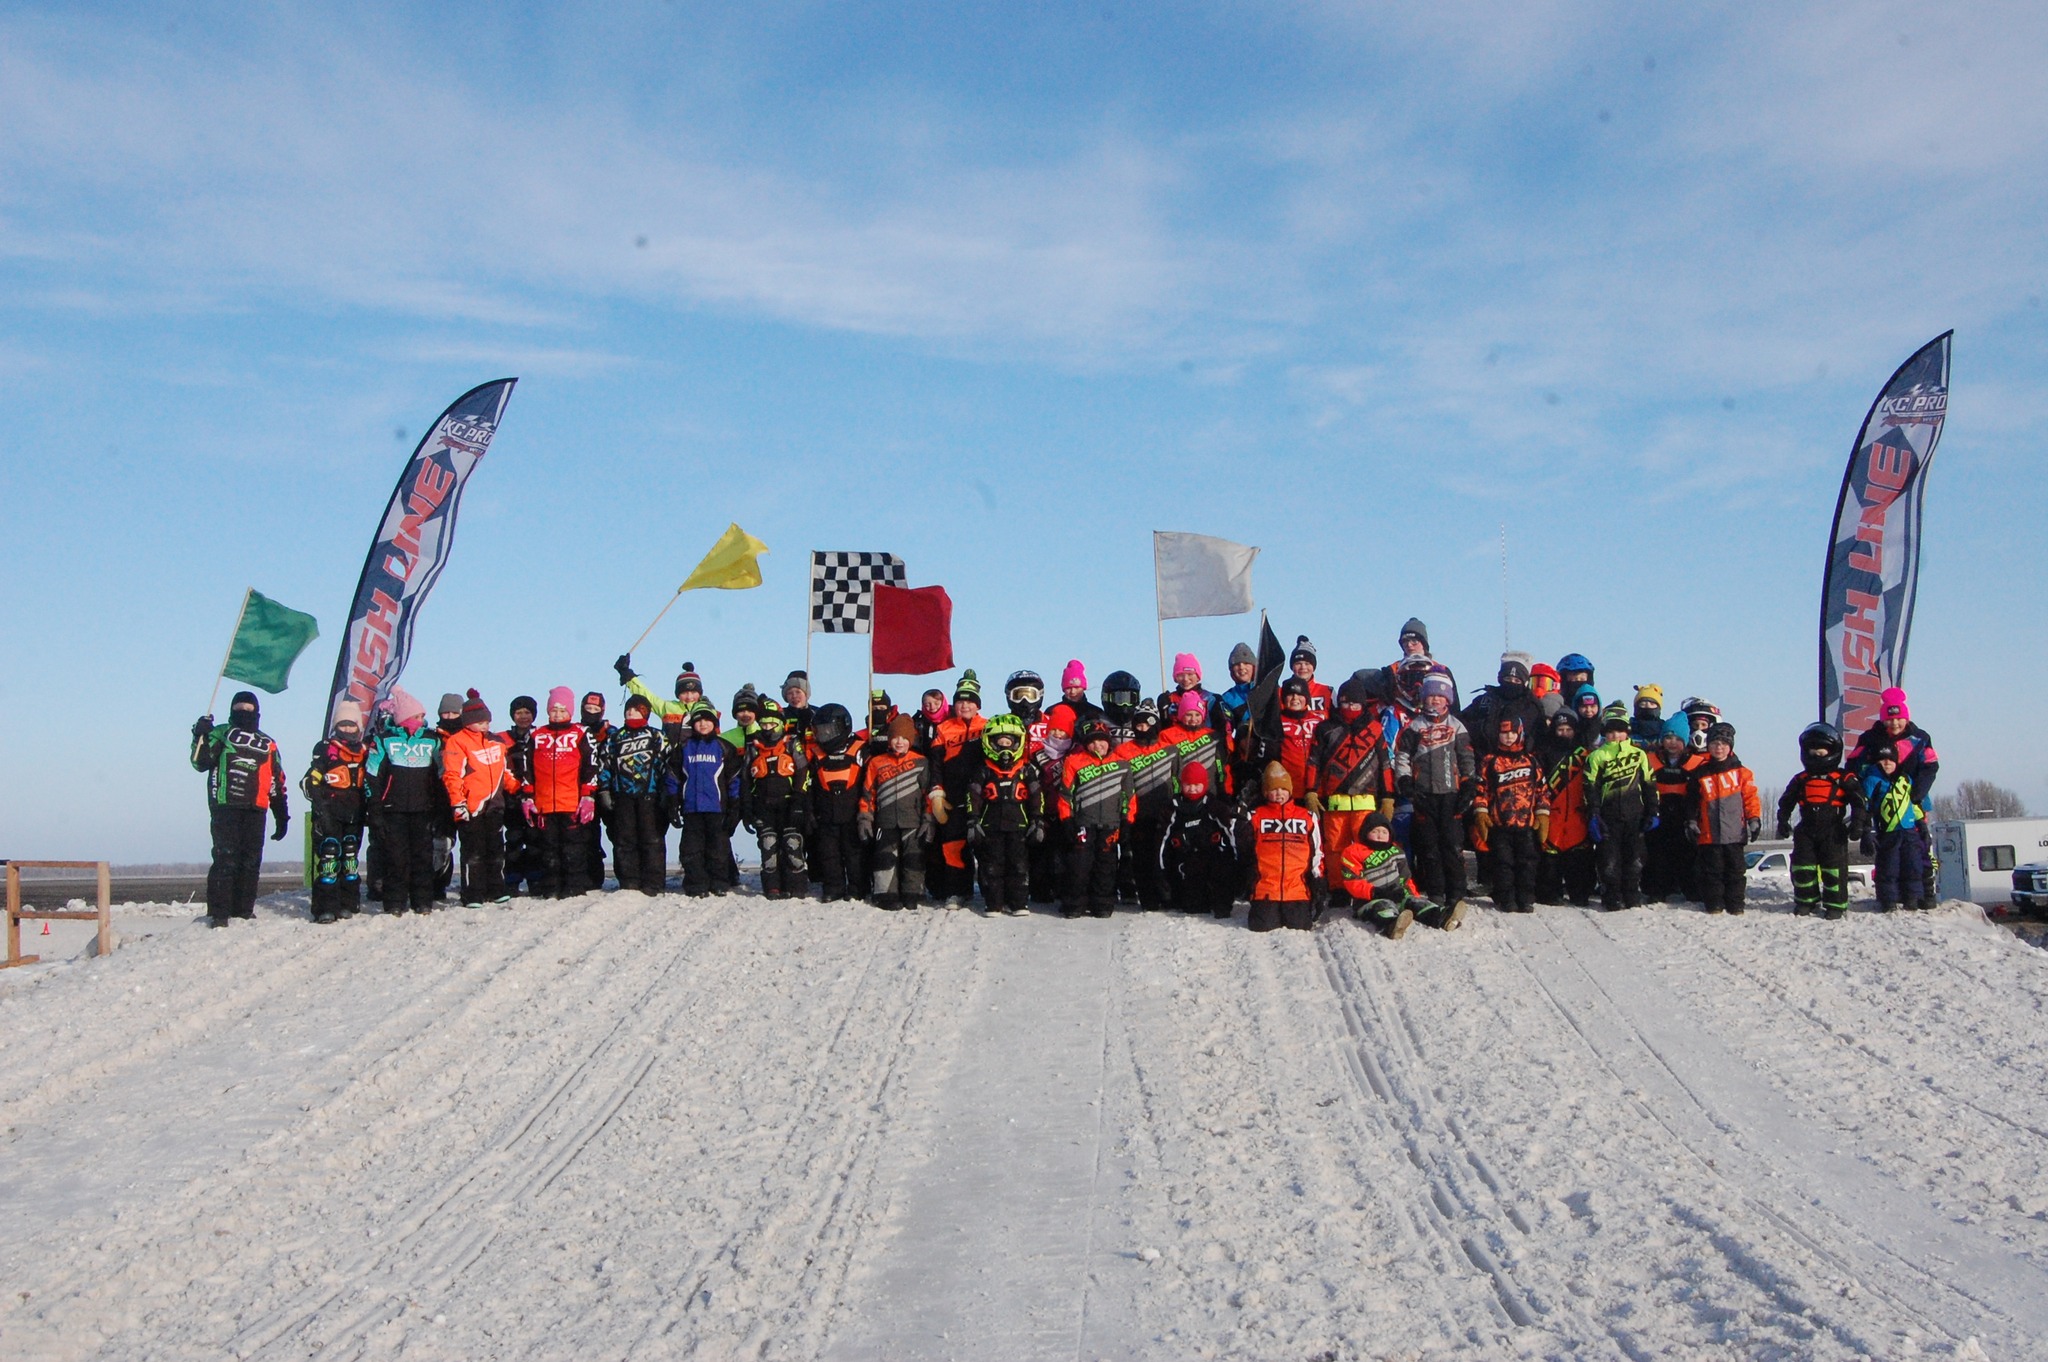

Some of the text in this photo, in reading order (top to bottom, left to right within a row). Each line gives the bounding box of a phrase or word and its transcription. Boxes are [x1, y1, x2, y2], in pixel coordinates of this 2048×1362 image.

[1883, 395, 1947, 415] KC PRO
[442, 419, 467, 437] KC
[348, 456, 454, 728] NISH LINE
[1841, 442, 1911, 758] NISH LINE
[227, 727, 272, 752] 68
[534, 731, 579, 749] FXR
[620, 739, 649, 754] FXR
[1337, 728, 1376, 768] FXR
[389, 742, 433, 757] FXR
[688, 754, 716, 763] YAMAHA
[1080, 762, 1119, 783] ARCTIC
[1498, 768, 1531, 783] FXR
[1702, 770, 1739, 794] FLY
[1261, 819, 1307, 835] FXR
